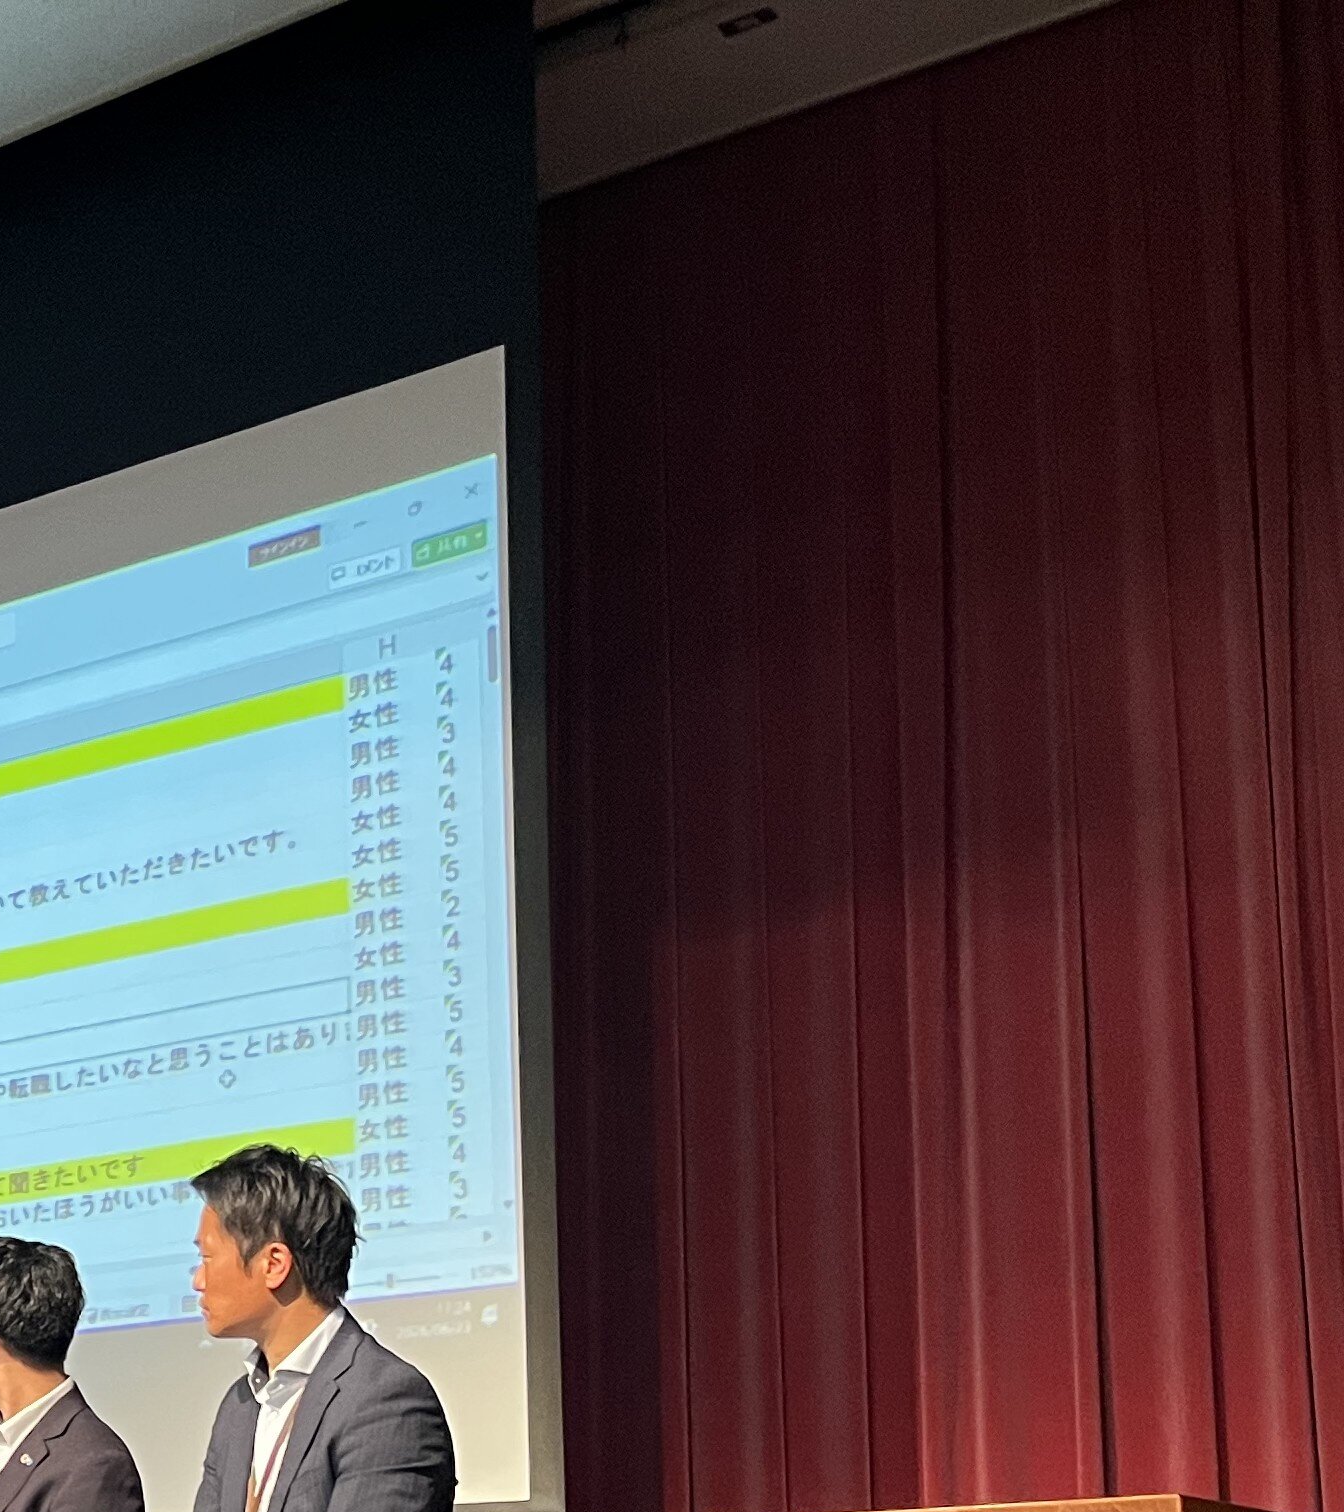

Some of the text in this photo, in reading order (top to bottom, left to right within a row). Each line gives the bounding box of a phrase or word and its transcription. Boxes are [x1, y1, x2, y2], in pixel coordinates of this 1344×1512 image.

[378, 634, 397, 659] H
[439, 653, 454, 674] 4
[349, 667, 398, 701] 男性
[440, 688, 454, 708] 4
[349, 701, 399, 734] 女性
[442, 722, 456, 743] 3
[350, 735, 400, 769] 男性
[443, 756, 456, 777] 4
[351, 769, 401, 803] 男性
[443, 790, 457, 811] 4
[352, 803, 402, 835] 女性
[444, 825, 458, 847] 5
[352, 837, 402, 868] 女性
[445, 859, 459, 882] 5
[353, 872, 403, 903] 女性
[446, 895, 460, 918] 2
[354, 906, 404, 938] 男性
[447, 930, 461, 951] 4
[355, 940, 406, 970] 女性
[449, 965, 462, 987] 3
[356, 975, 406, 1007] 男性
[450, 999, 463, 1023] 5
[356, 1009, 407, 1041] 男性
[450, 1034, 463, 1057] 4
[358, 1045, 408, 1076] 男性
[451, 1070, 465, 1094] 5
[358, 1079, 410, 1111] 男性
[358, 1114, 410, 1143] 女性
[452, 1106, 466, 1128] 5
[360, 1149, 411, 1178] 男性
[453, 1142, 466, 1163] 4
[360, 1184, 412, 1213] 男性
[454, 1176, 468, 1200] 3
